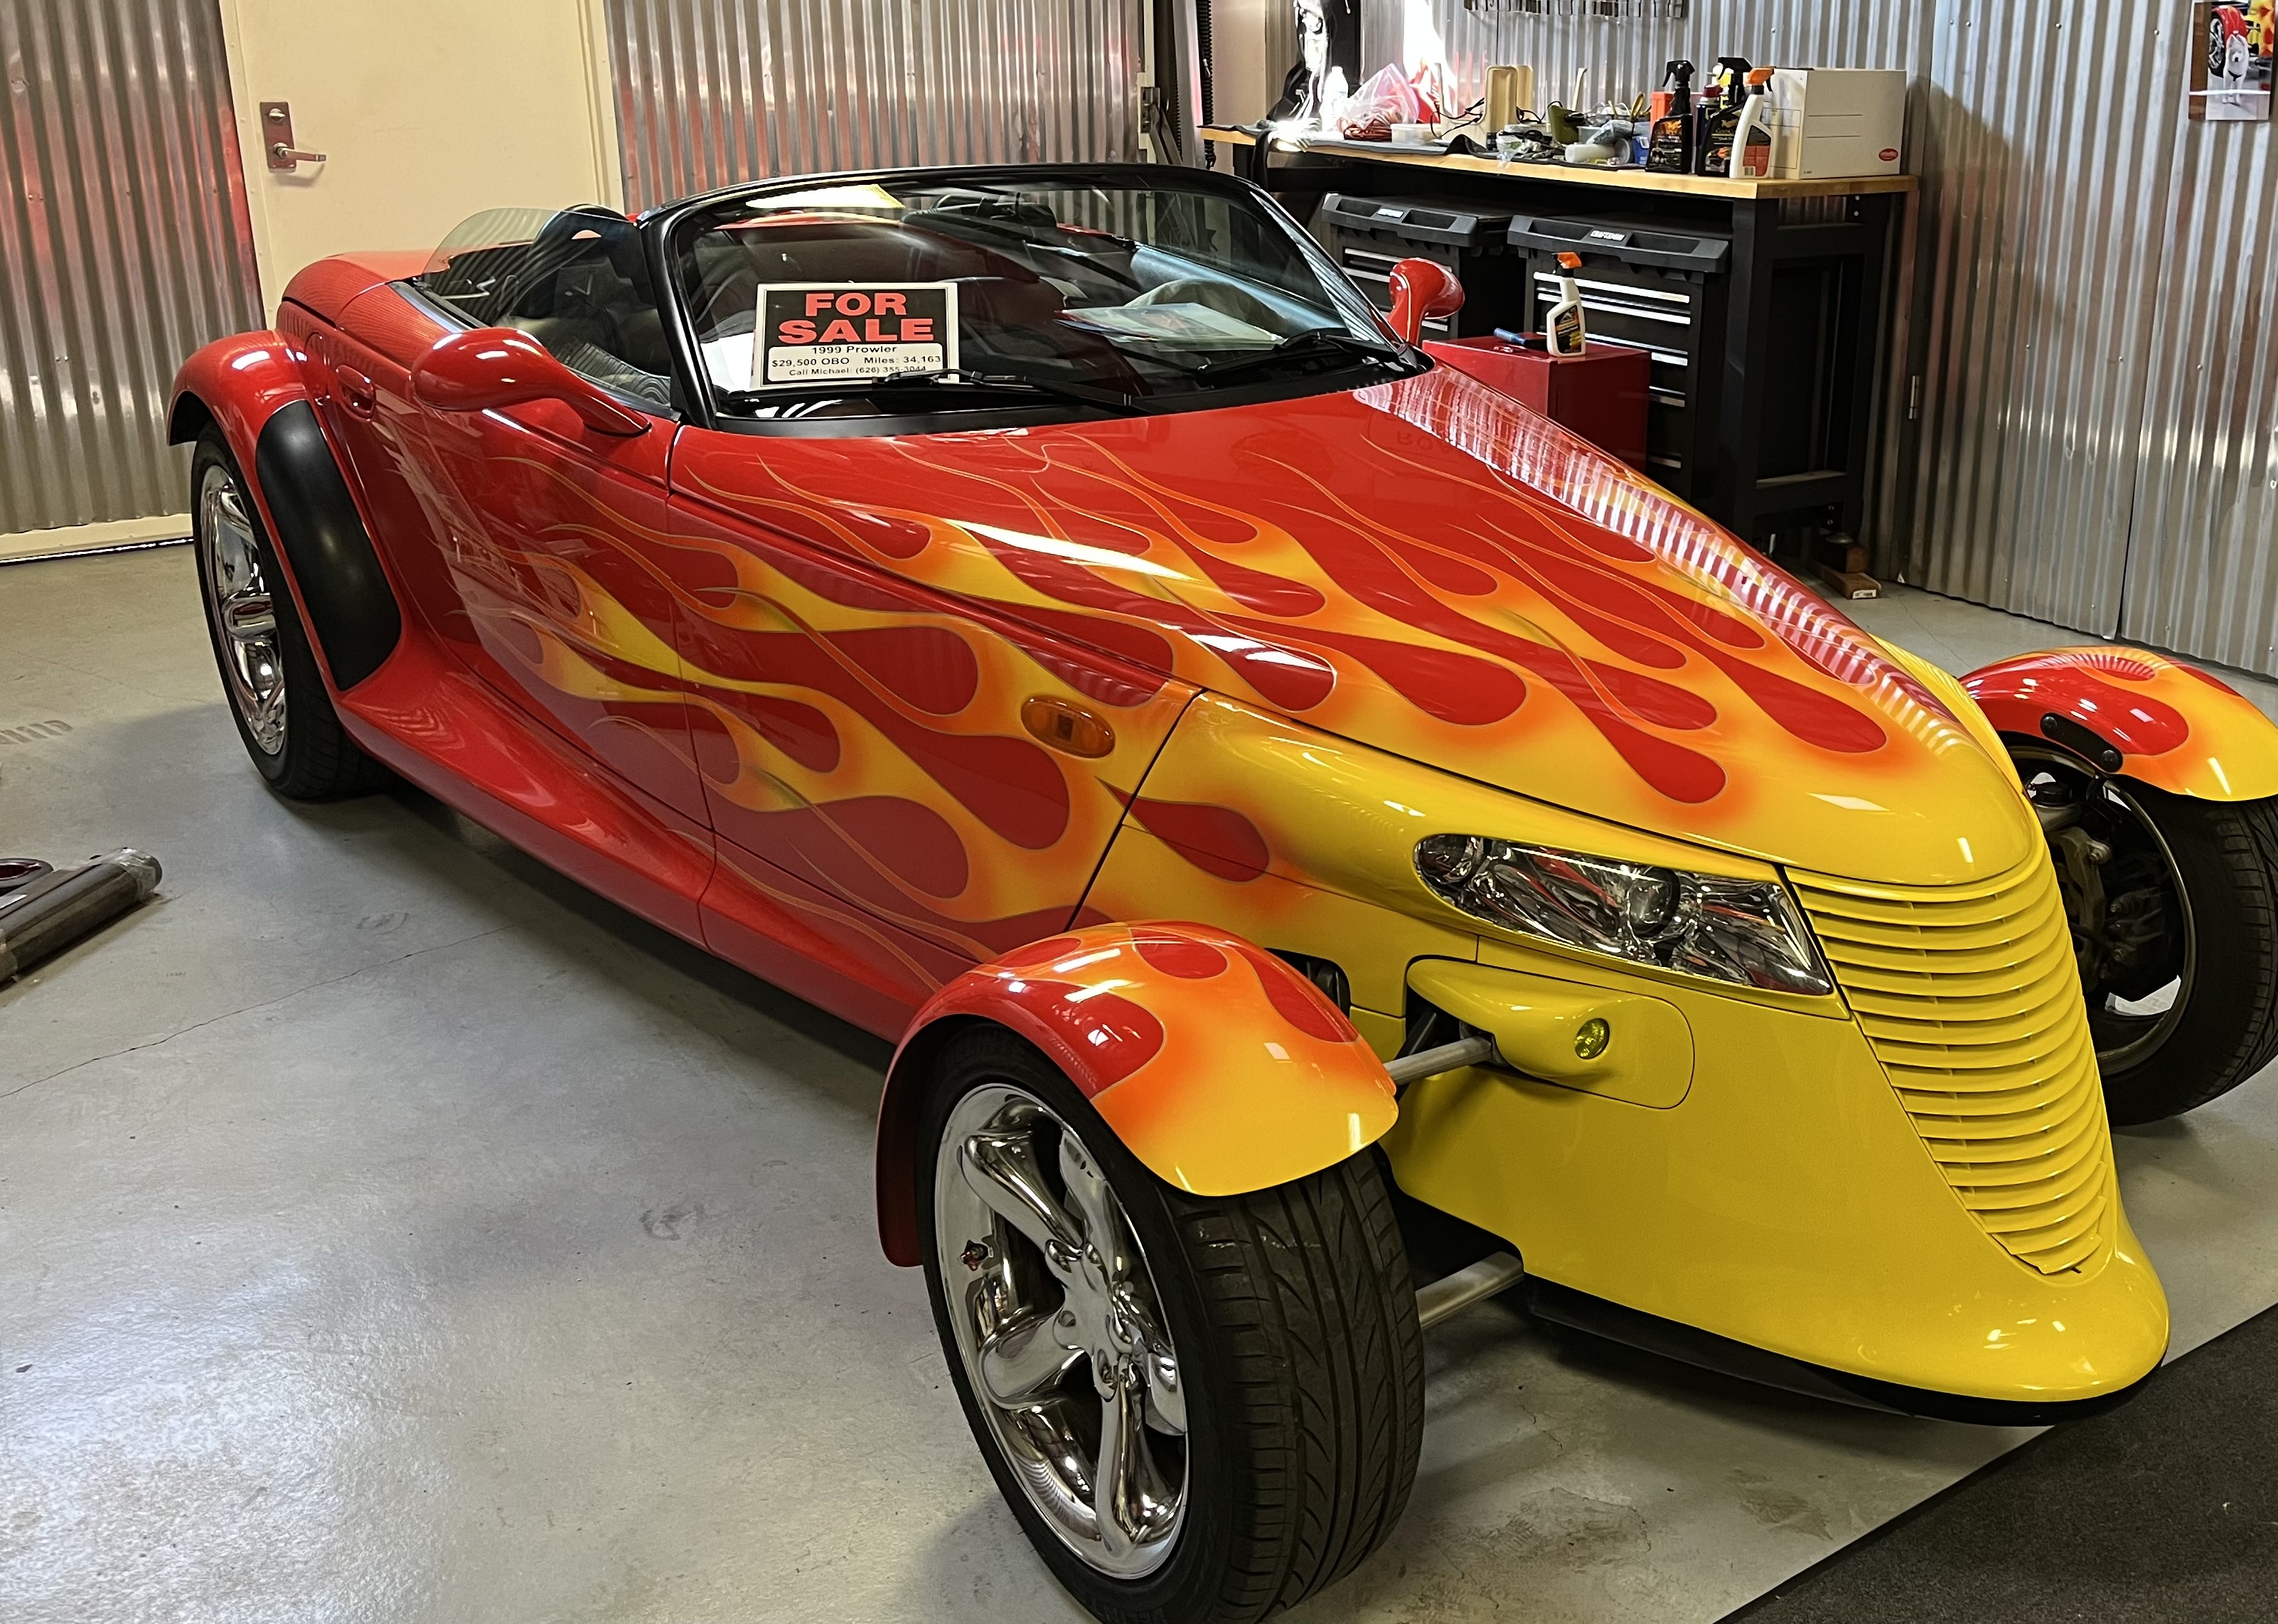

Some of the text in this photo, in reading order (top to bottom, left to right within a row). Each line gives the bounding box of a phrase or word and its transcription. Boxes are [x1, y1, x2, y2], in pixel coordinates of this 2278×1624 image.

[805, 292, 907, 316] FOR
[778, 318, 934, 344] SALE
[771, 358, 817, 368] $29,500
[903, 356, 941, 364] 34,163
